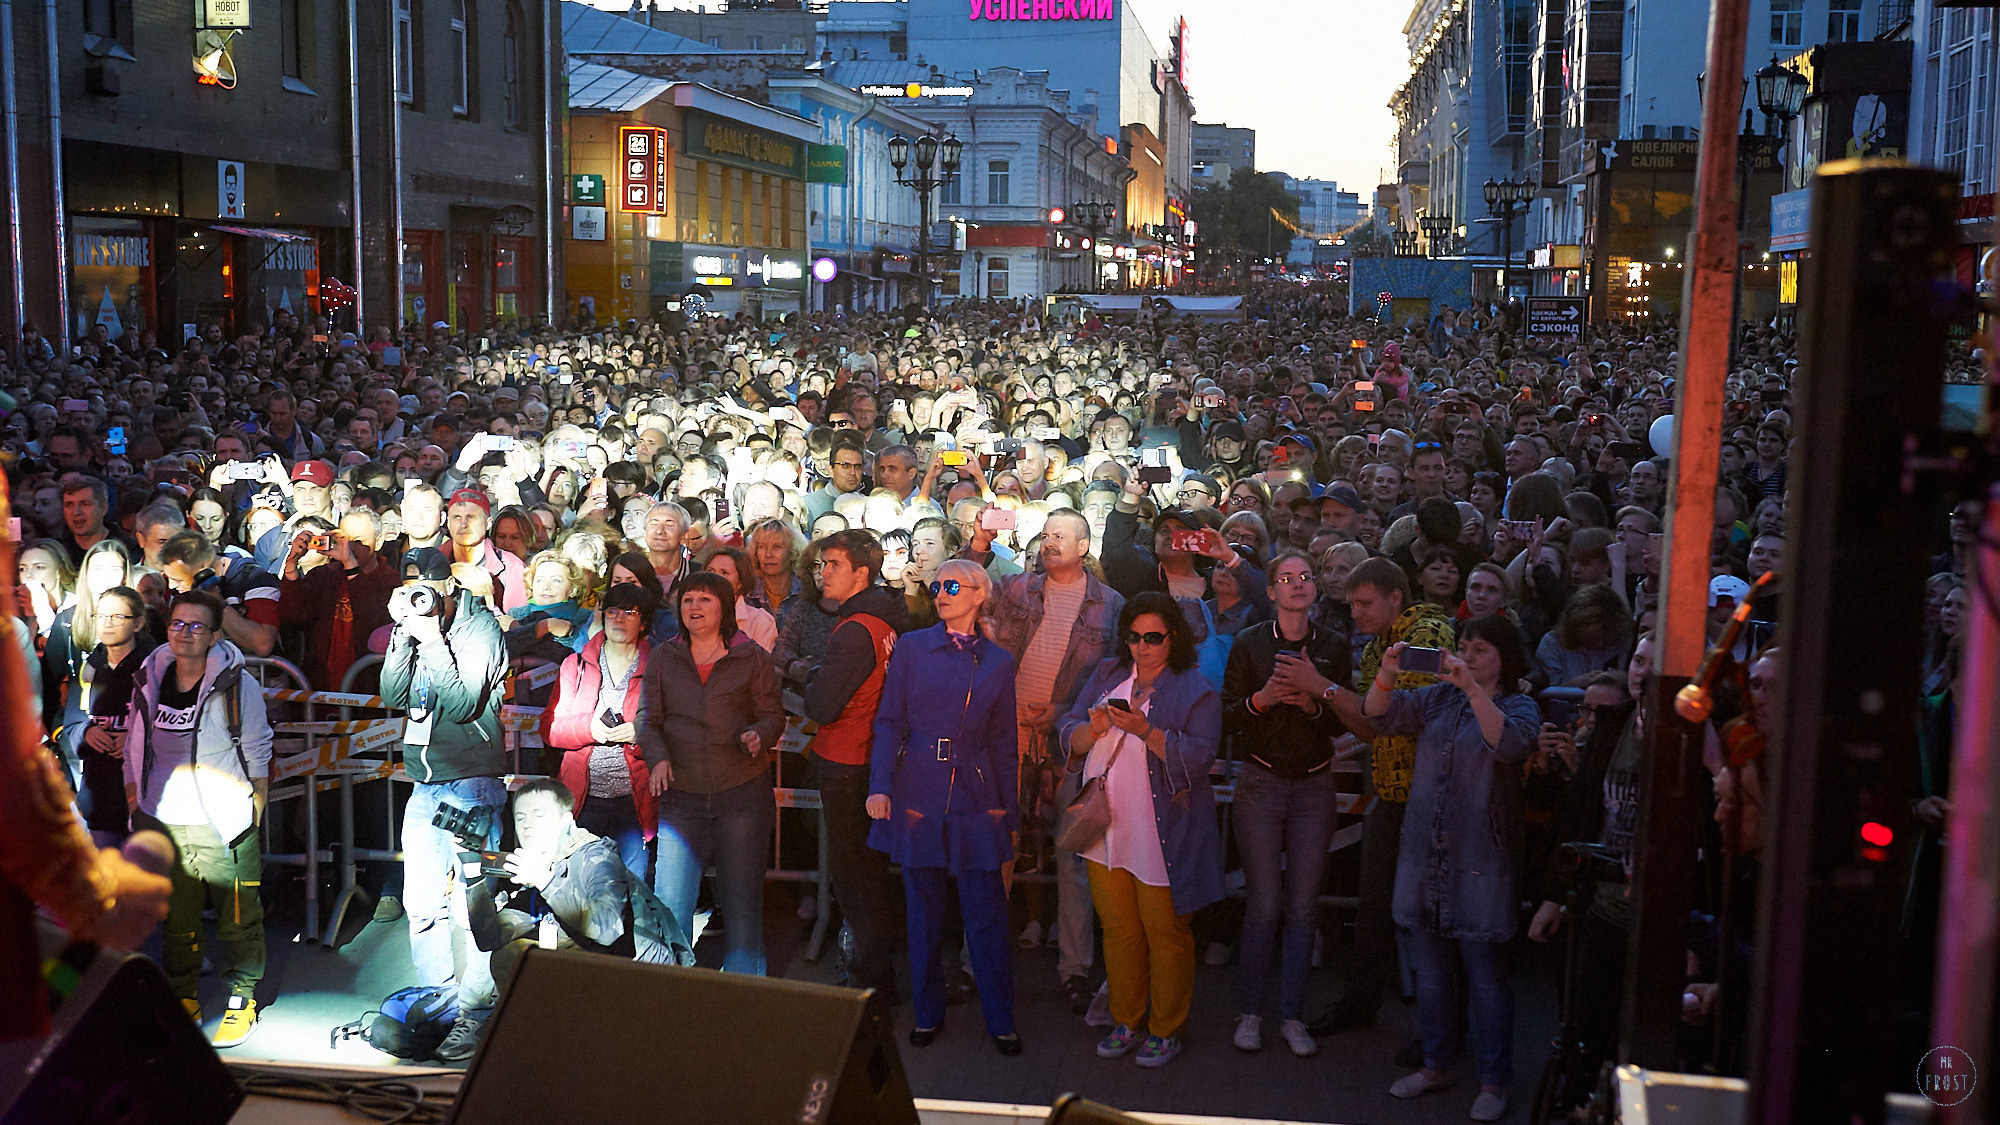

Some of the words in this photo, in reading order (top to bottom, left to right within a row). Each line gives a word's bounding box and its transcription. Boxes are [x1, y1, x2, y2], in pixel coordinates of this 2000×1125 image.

[1632, 142, 1697, 154] ЮВЕЛИРН
[1632, 156, 1673, 168] САЛОН
[107, 236, 150, 266] STORE
[286, 243, 316, 270] STORE
[1780, 261, 1797, 304] BAR
[1531, 324, 1580, 334] СЭКОНД
[328, 698, 360, 706] МОТИВ
[367, 728, 397, 743] МОТИВ
[284, 758, 314, 772] МОТИВ
[788, 793, 820, 803] МОТИВ
